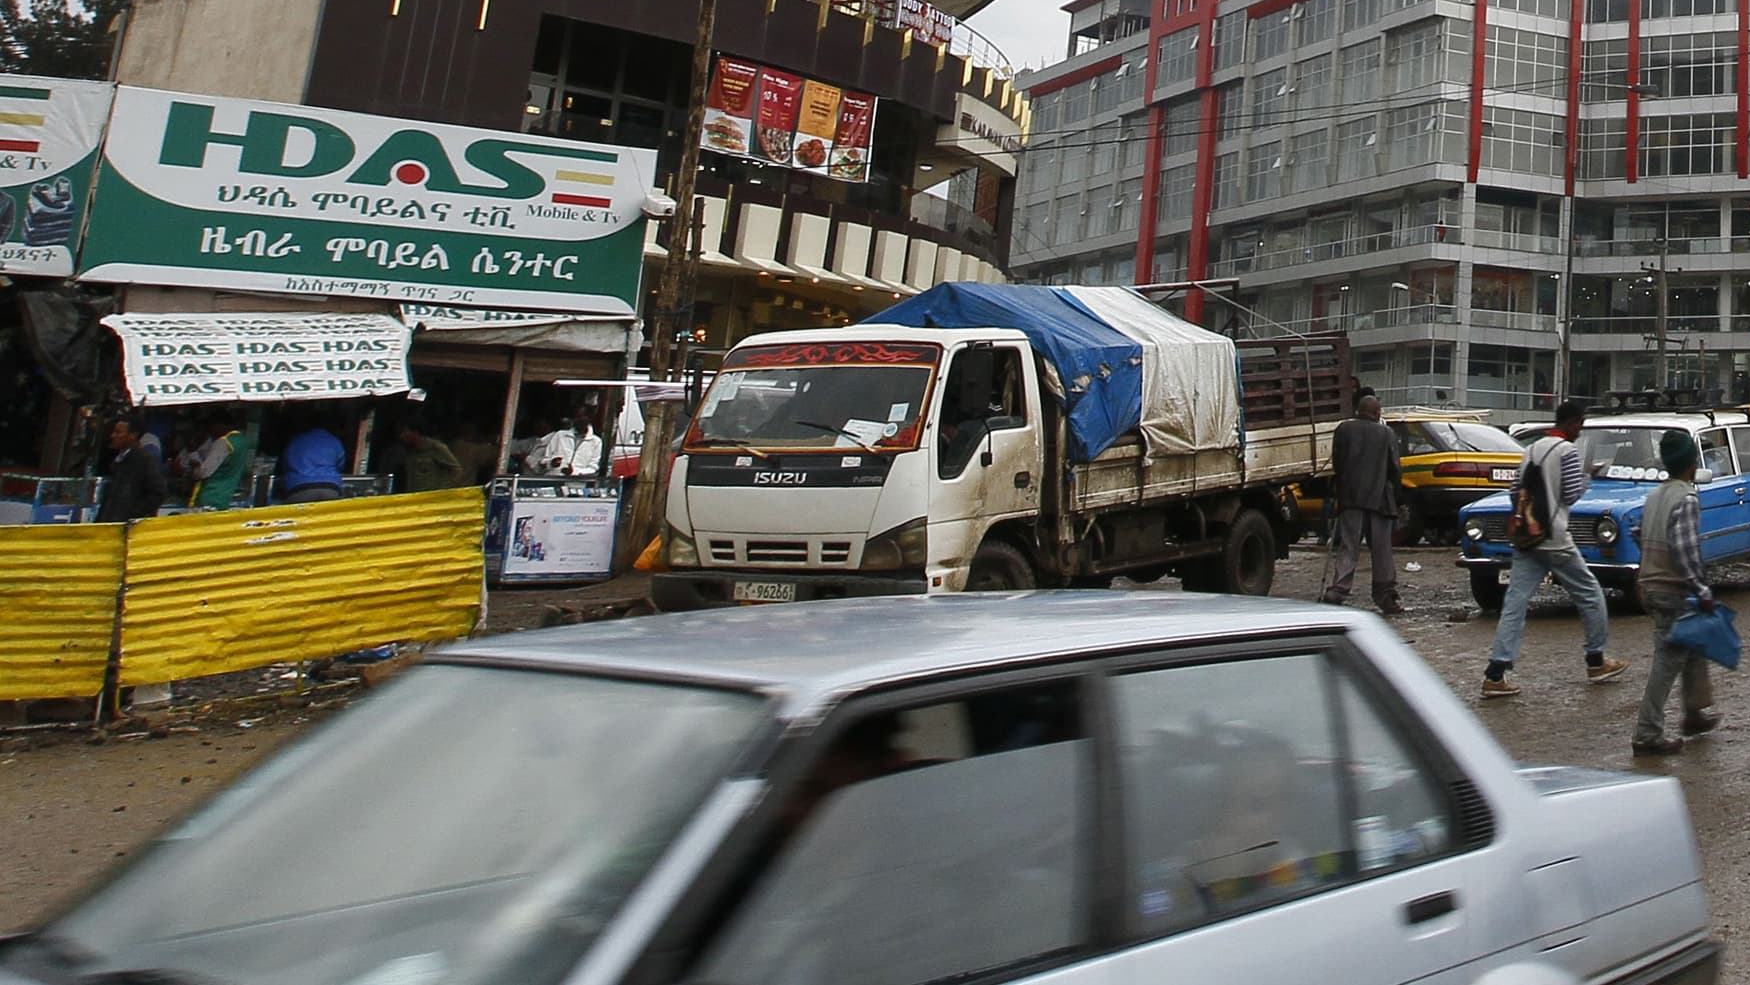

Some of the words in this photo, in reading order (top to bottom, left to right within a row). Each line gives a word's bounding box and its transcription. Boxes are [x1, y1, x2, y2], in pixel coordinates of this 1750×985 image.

[25, 156, 52, 171] Tv
[217, 184, 297, 208] ህዳሴ
[311, 192, 451, 222] ሞባይልና
[526, 204, 579, 222] Mobile
[582, 211, 597, 222] &
[601, 212, 621, 224] Tv
[200, 226, 301, 258] ዜብራ
[326, 237, 450, 271] ሞባይል
[471, 247, 579, 281] ሴንተር
[449, 291, 475, 303] ጋር
[753, 472, 808, 484] ISUZU
[757, 583, 789, 600] 96266
